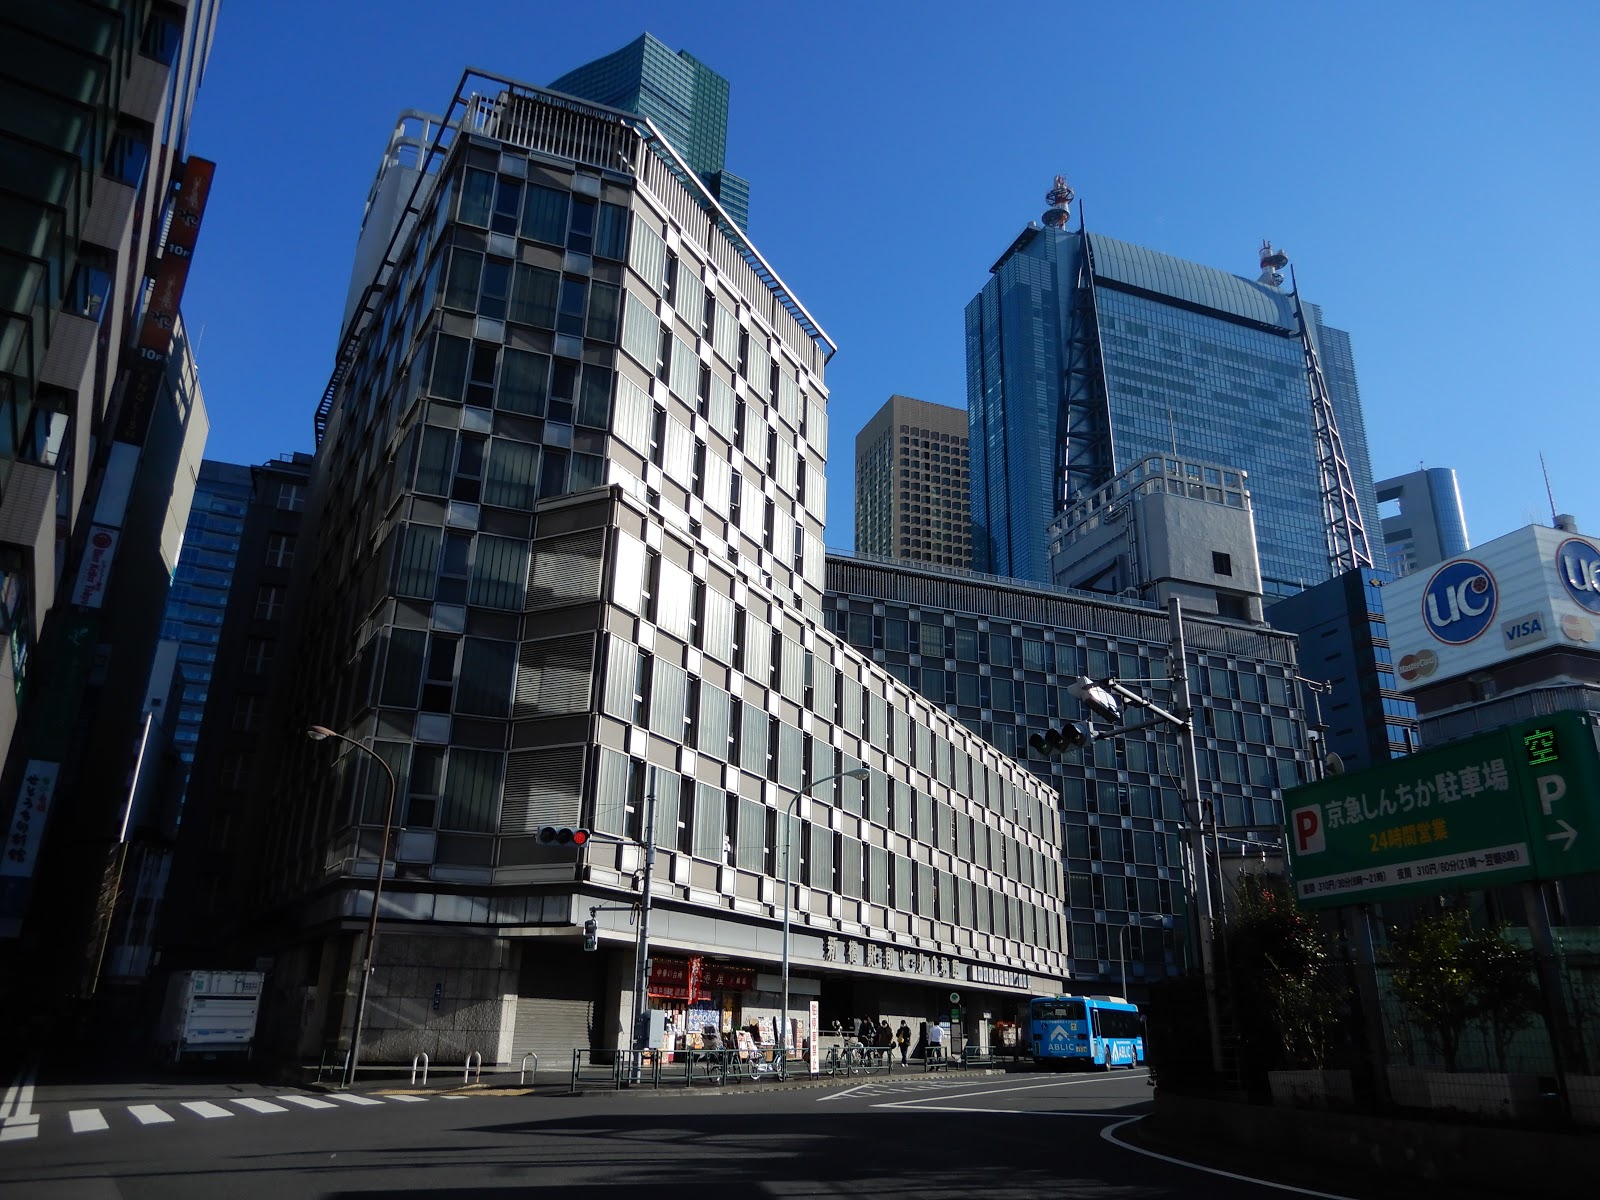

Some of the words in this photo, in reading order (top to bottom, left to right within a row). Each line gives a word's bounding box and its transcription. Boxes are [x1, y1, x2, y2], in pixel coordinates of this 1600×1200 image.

[169, 243, 191, 258] 10F
[140, 347, 163, 362] 10F
[1427, 573, 1490, 627] UC
[1505, 618, 1542, 641] VISA
[1398, 655, 1435, 674] MasterCard
[1523, 729, 1559, 766] 空
[1325, 758, 1511, 829] 京急しんちか駐車場
[1536, 774, 1567, 816] P
[1296, 810, 1319, 851] P
[1368, 817, 1449, 854] 24時間営業
[1396, 866, 1413, 880] 夜間
[1047, 1043, 1075, 1051] ABLIC
